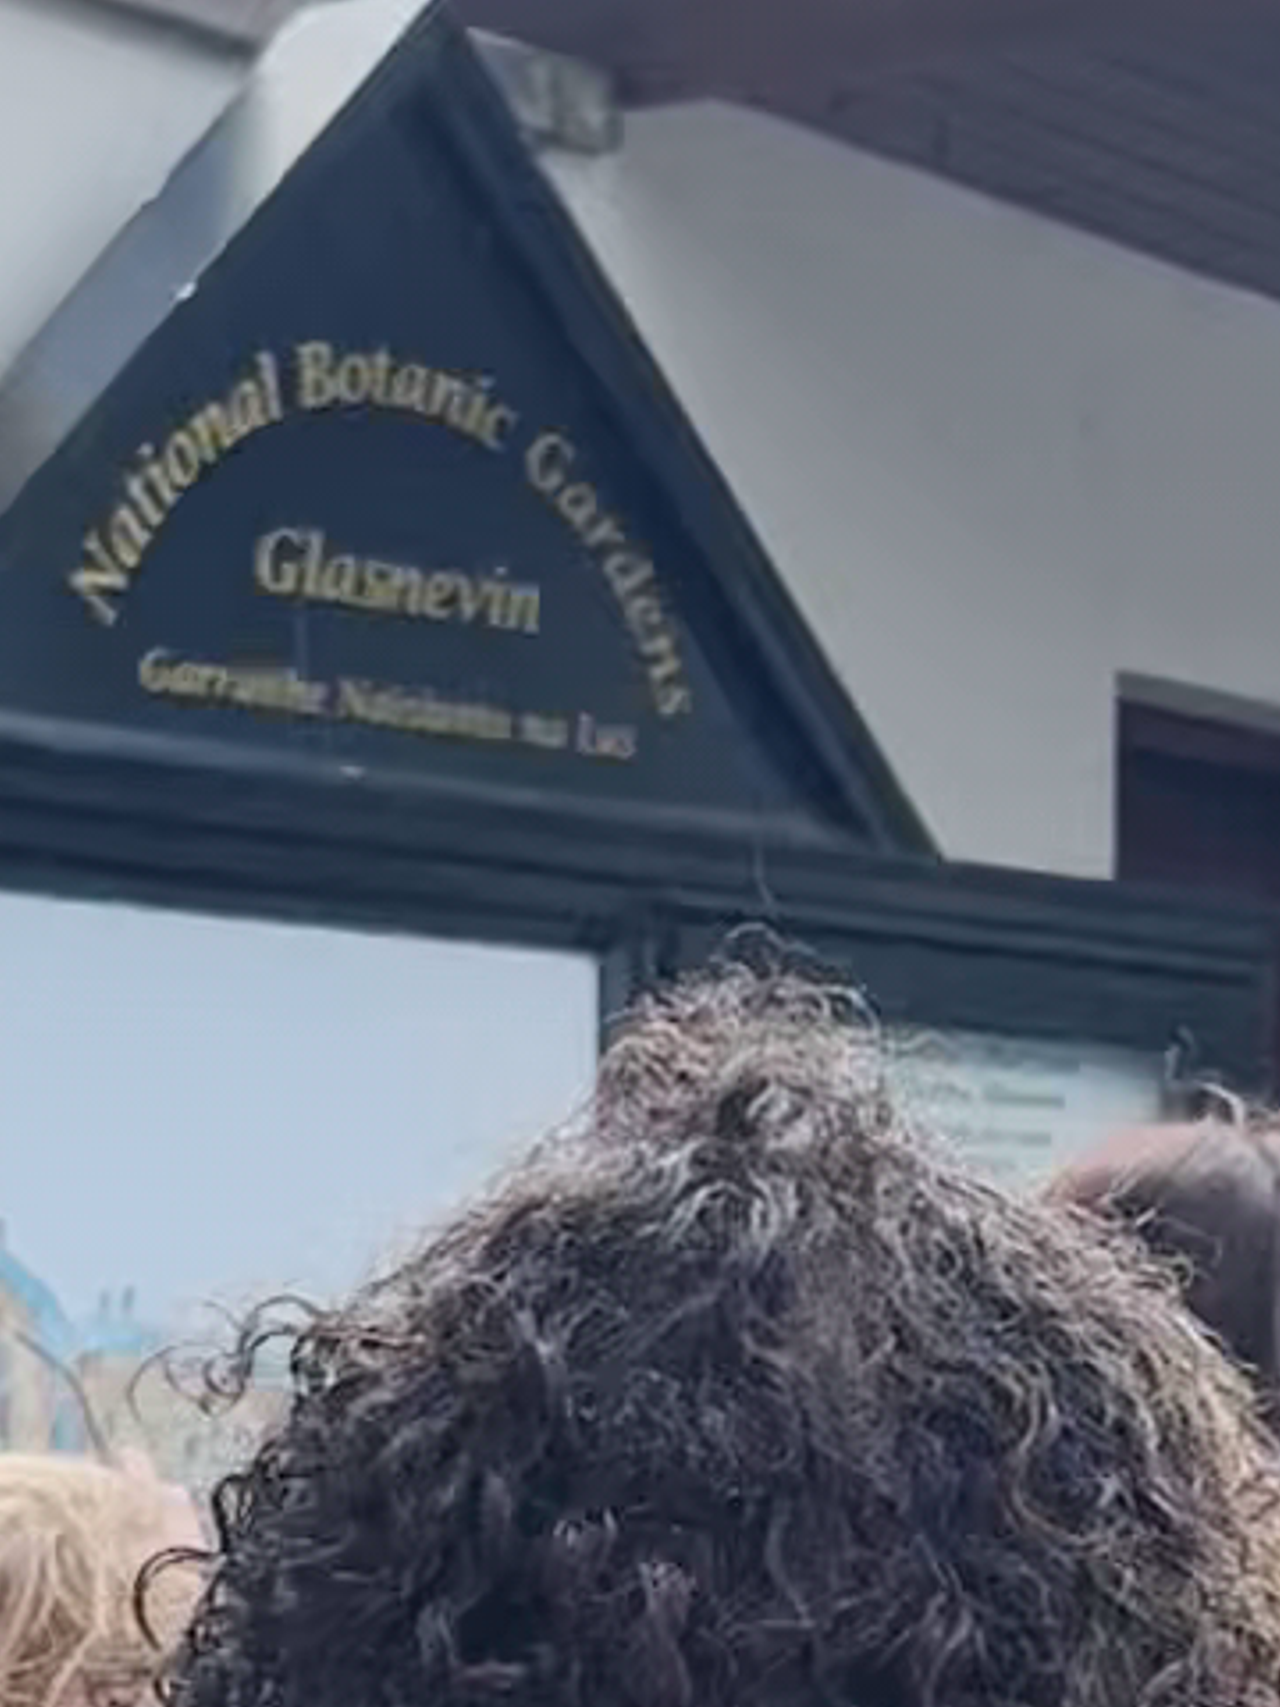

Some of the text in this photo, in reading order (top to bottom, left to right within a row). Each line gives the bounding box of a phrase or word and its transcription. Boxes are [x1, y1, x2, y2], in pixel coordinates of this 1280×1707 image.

[70, 338, 690, 715] National Botanic Gardens
[255, 525, 541, 634] Glasnevin
